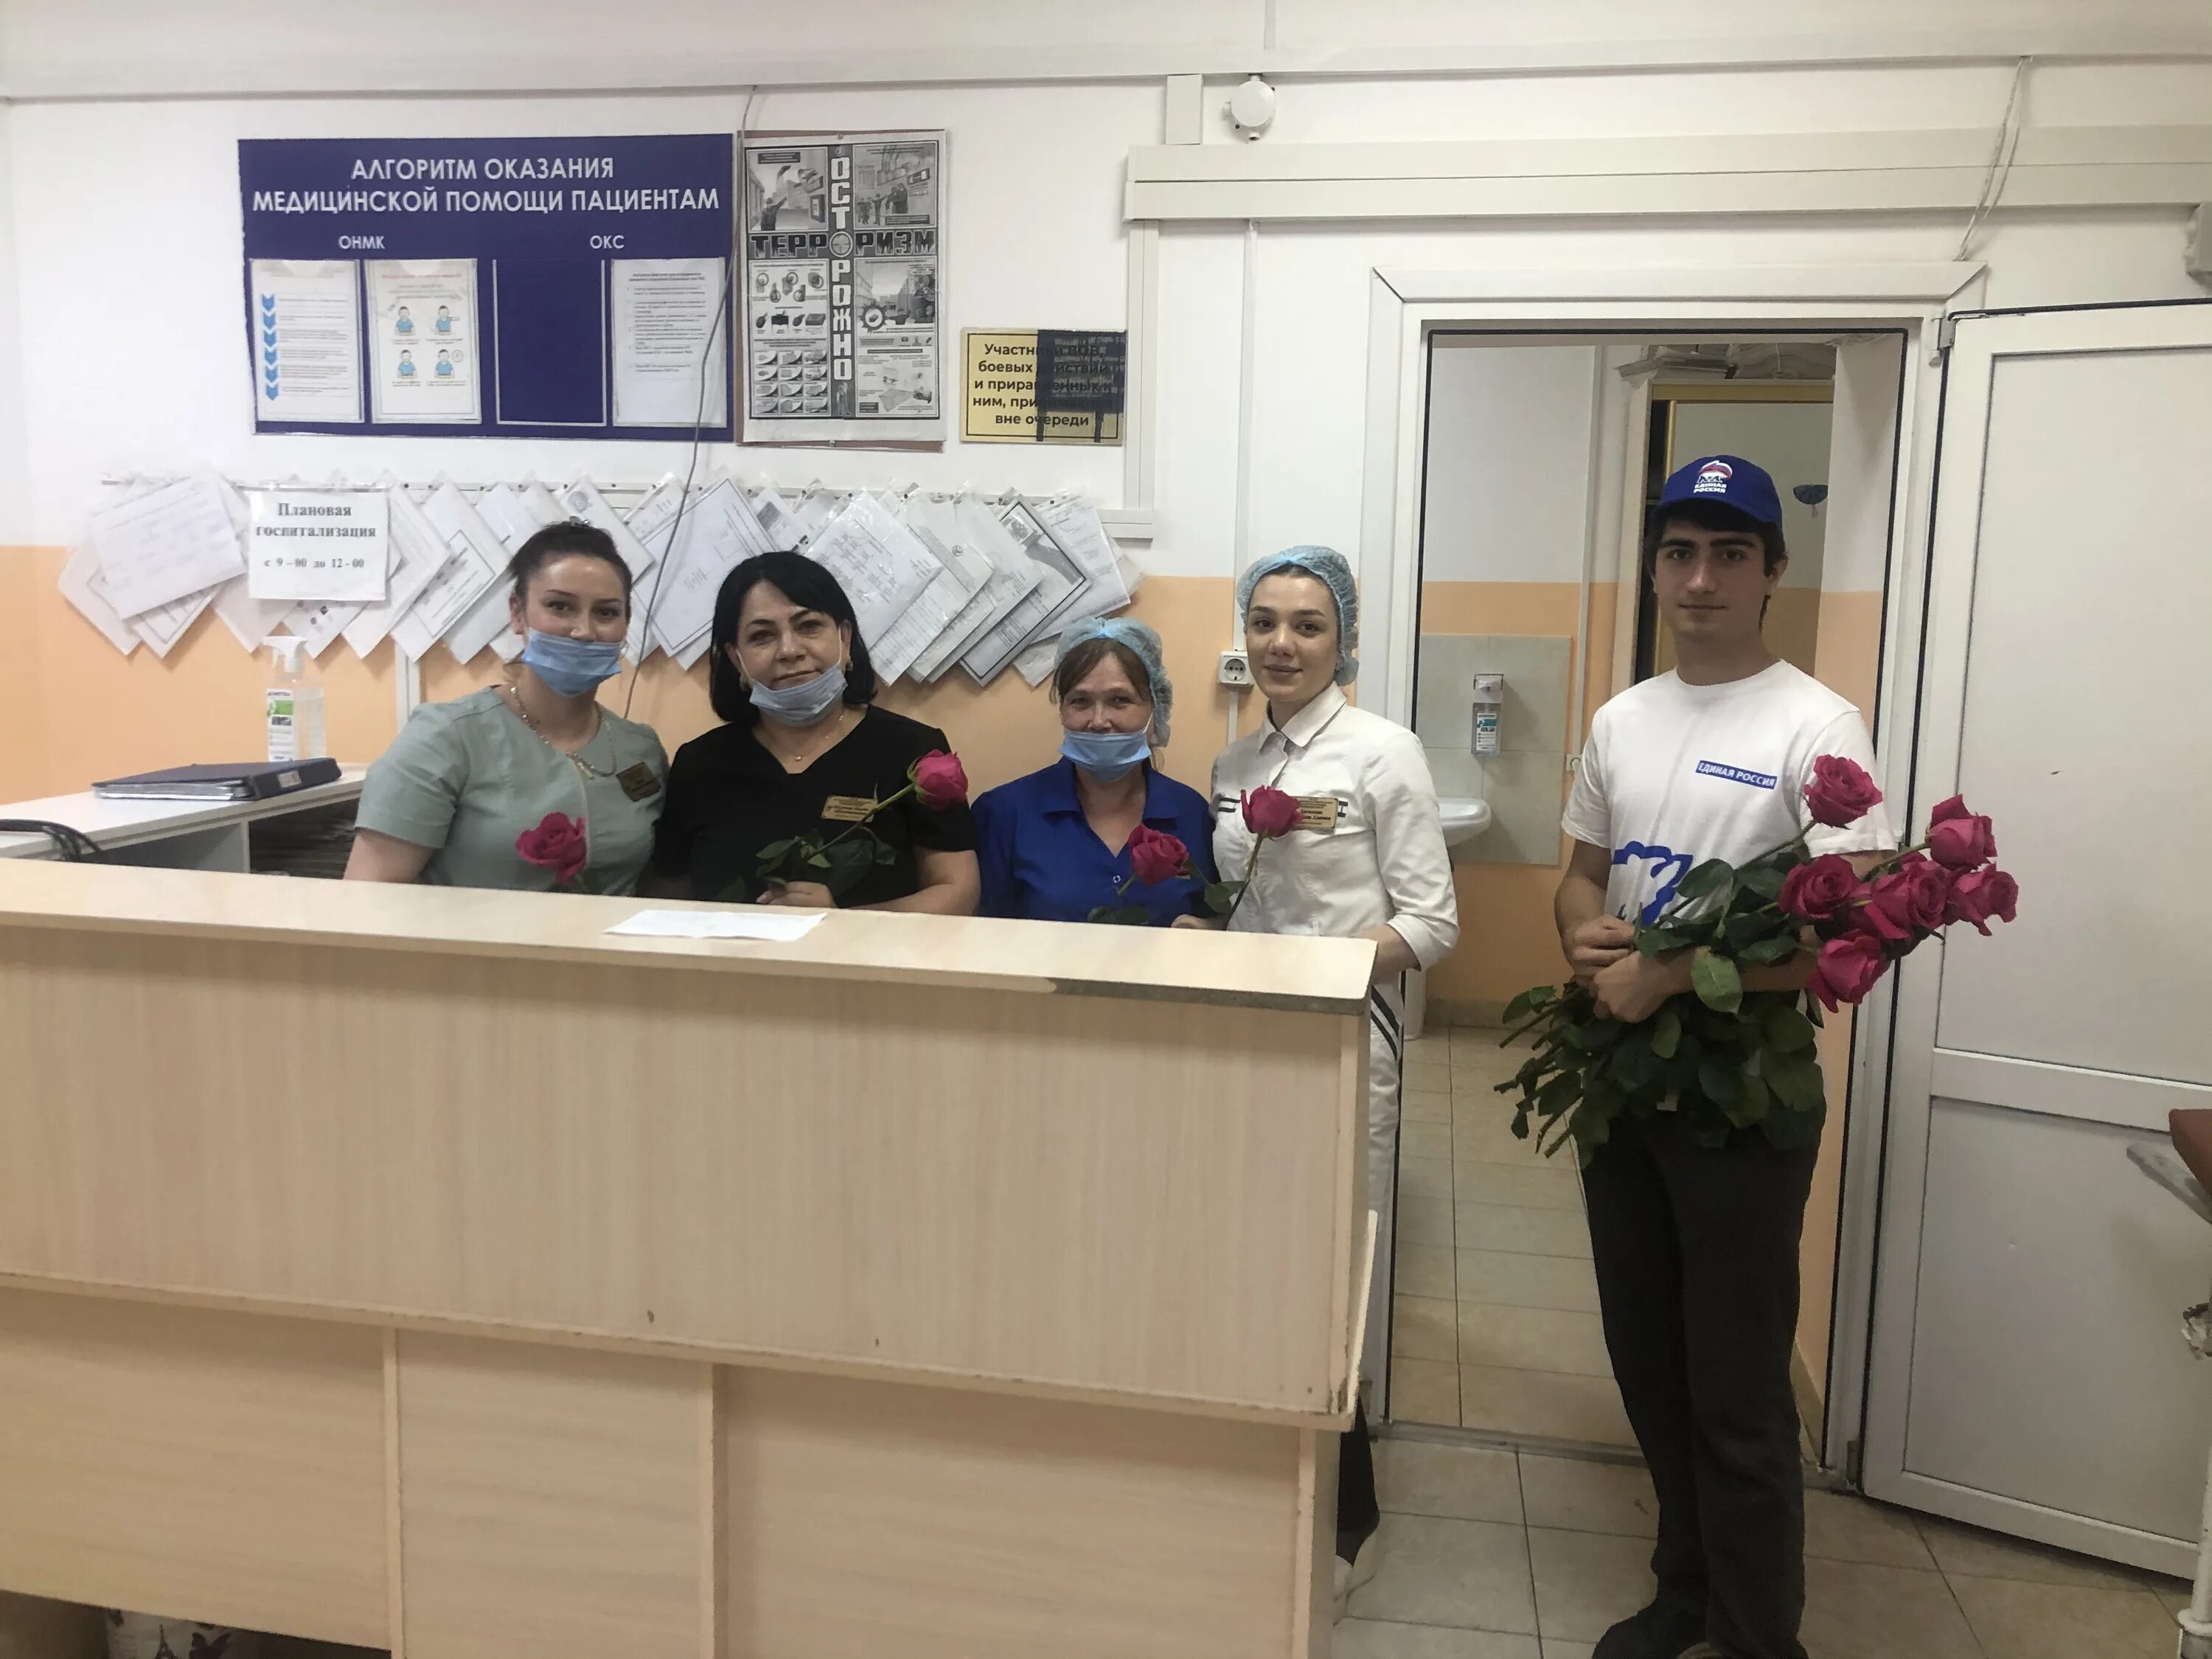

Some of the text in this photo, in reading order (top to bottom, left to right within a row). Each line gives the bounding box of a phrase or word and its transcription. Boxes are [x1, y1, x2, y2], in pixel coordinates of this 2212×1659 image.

[350, 157, 614, 179] АЛГОРИТМ ОКАЗАНИЯ
[252, 186, 720, 214] МЕДИЦИНСКОЙ ПОМОЩИ ПАЦИЕНТАМ
[338, 234, 386, 249] ОНМК
[589, 234, 625, 249] ОКС
[978, 360, 1033, 373] боевых
[974, 380, 984, 389] и
[973, 397, 1006, 409] ним,
[995, 415, 1022, 425] вне
[277, 503, 352, 517] Плановая
[255, 526, 377, 538] госпитализация
[1698, 762, 1776, 787] ЕДИНАЯ РОССИЯ
